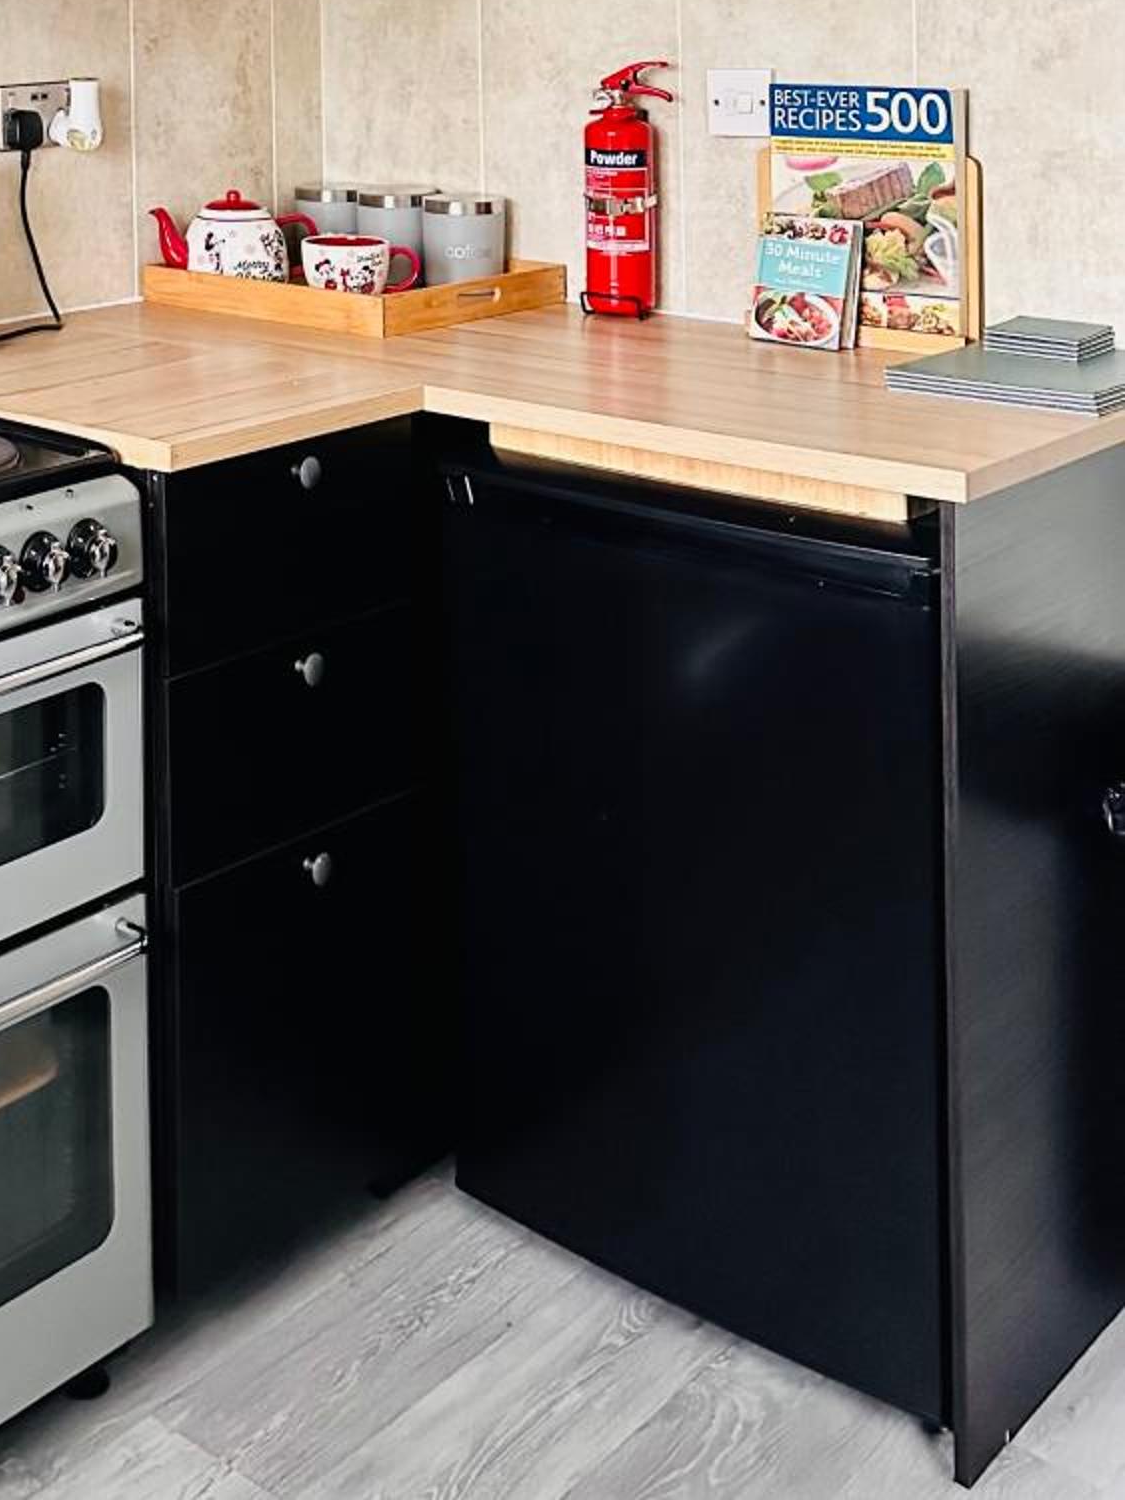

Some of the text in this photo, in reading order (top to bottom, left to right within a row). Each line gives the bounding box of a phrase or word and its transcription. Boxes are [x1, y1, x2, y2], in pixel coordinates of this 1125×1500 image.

[774, 89, 860, 108] BEST-EVER
[774, 107, 862, 132] RECIPES
[864, 91, 948, 136] 500
[589, 149, 638, 166] Powder
[778, 259, 825, 279] Meals
